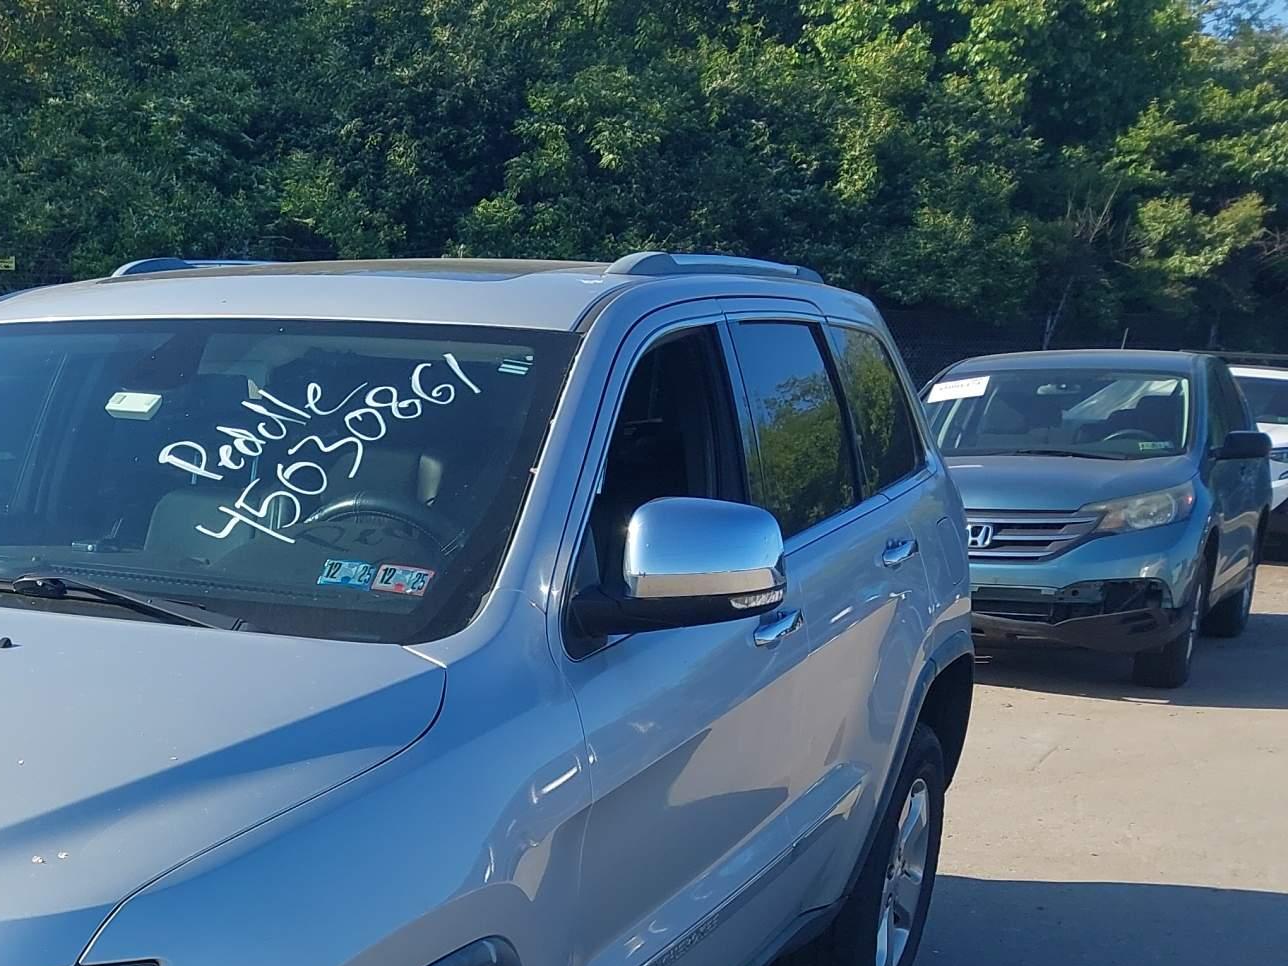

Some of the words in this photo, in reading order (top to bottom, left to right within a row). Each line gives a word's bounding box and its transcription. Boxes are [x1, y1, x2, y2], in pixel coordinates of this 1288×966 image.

[158, 382, 368, 481] Peddle
[195, 353, 481, 544] 45030861
[325, 562, 343, 579] 12
[358, 565, 373, 584] 25
[379, 567, 397, 585] 12
[411, 572, 428, 591] 25
